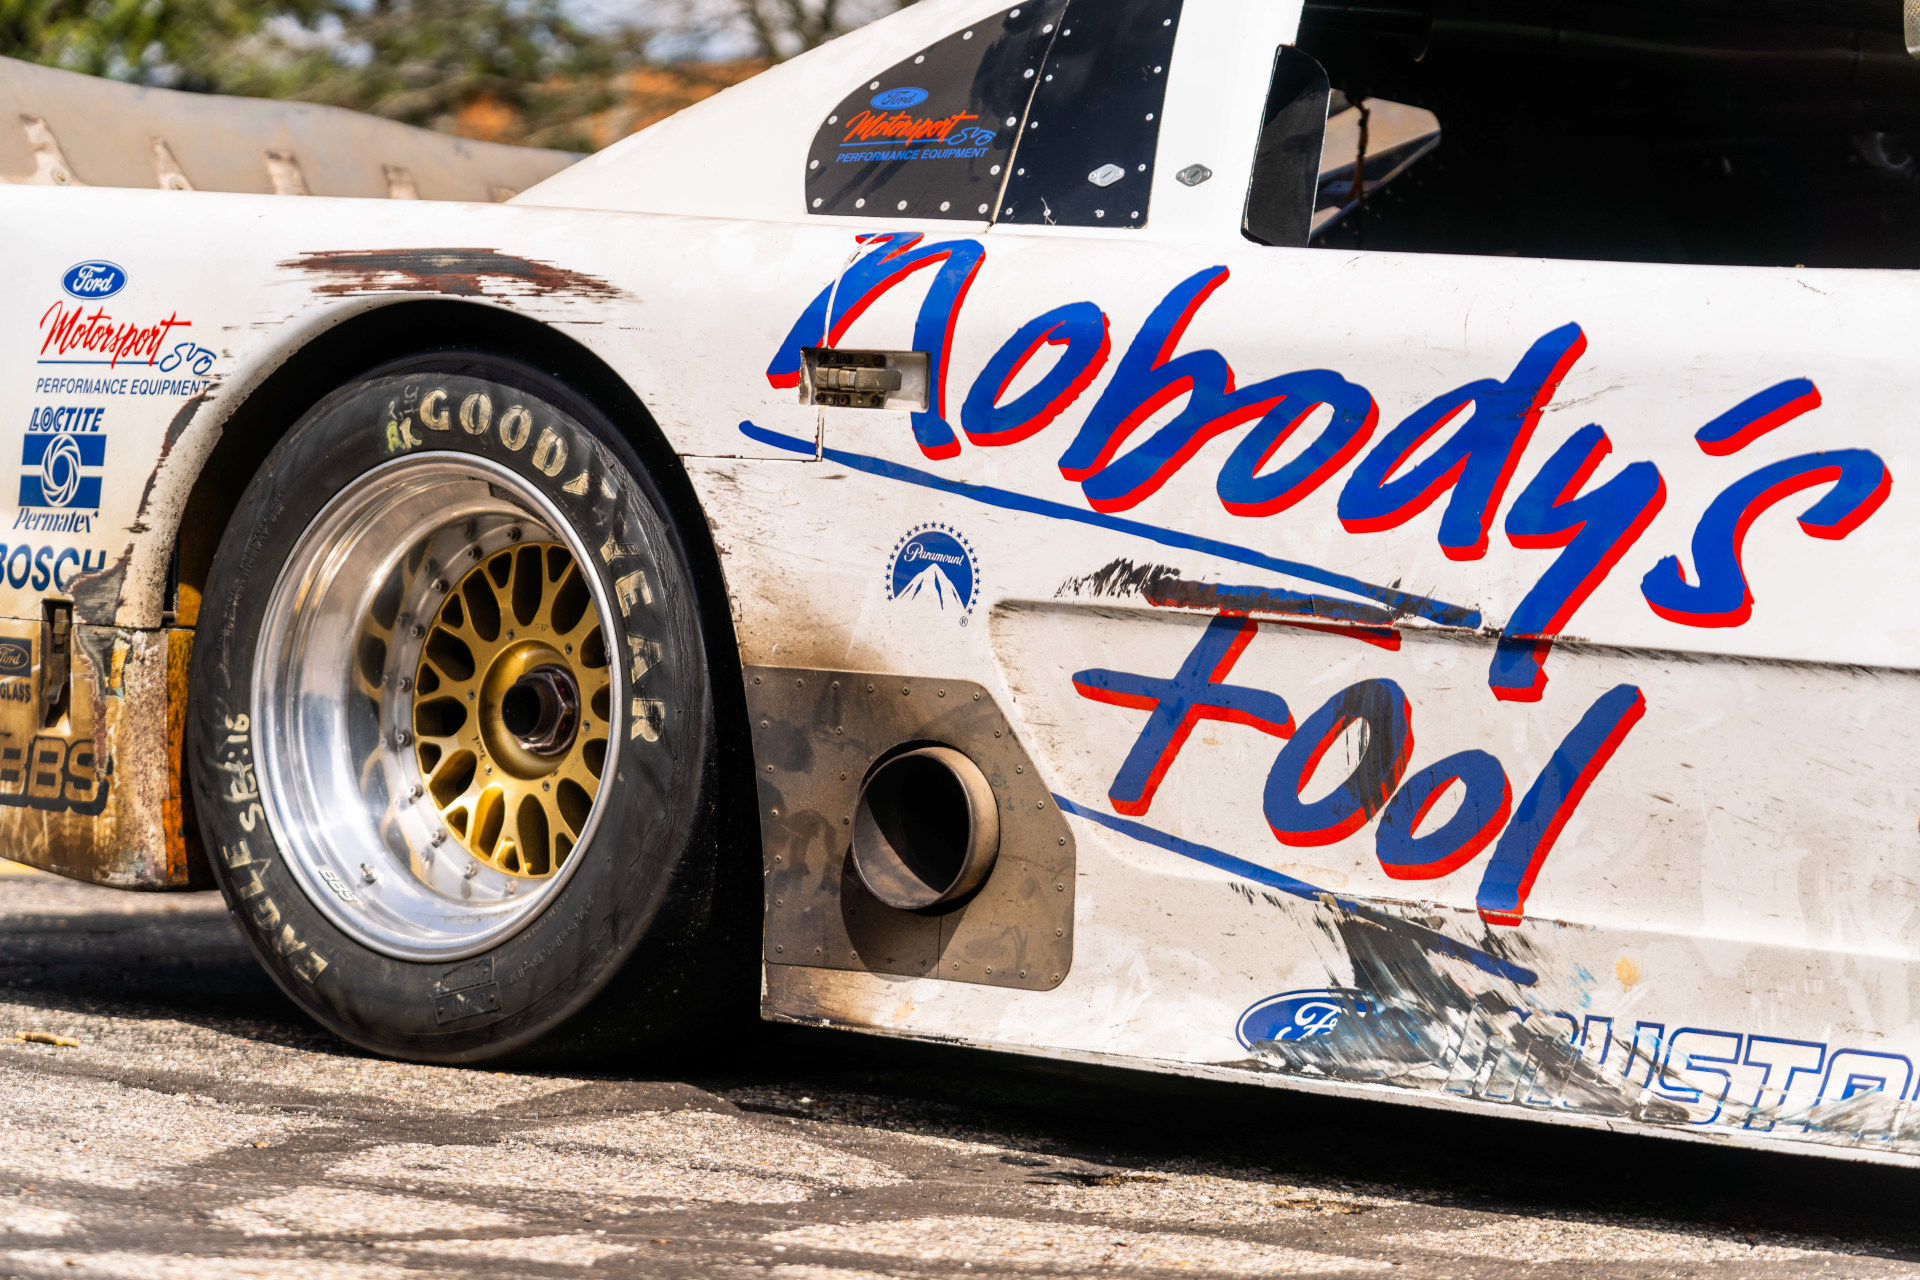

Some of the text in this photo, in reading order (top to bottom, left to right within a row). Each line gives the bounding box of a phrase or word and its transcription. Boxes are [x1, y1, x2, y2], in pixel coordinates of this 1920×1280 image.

[843, 109, 978, 147] Motorsport
[836, 148, 989, 163] PERFORMANCE EQUIPMENT
[39, 300, 192, 370] Motorsport
[36, 378, 210, 396] PERFORMANCE EQUIPMENT
[28, 406, 105, 433] LOCTITE
[12, 507, 99, 533] Permatex
[904, 542, 965, 566] Paramount
[1072, 575, 1647, 925] Fool
[221, 839, 329, 984] EAGLE
